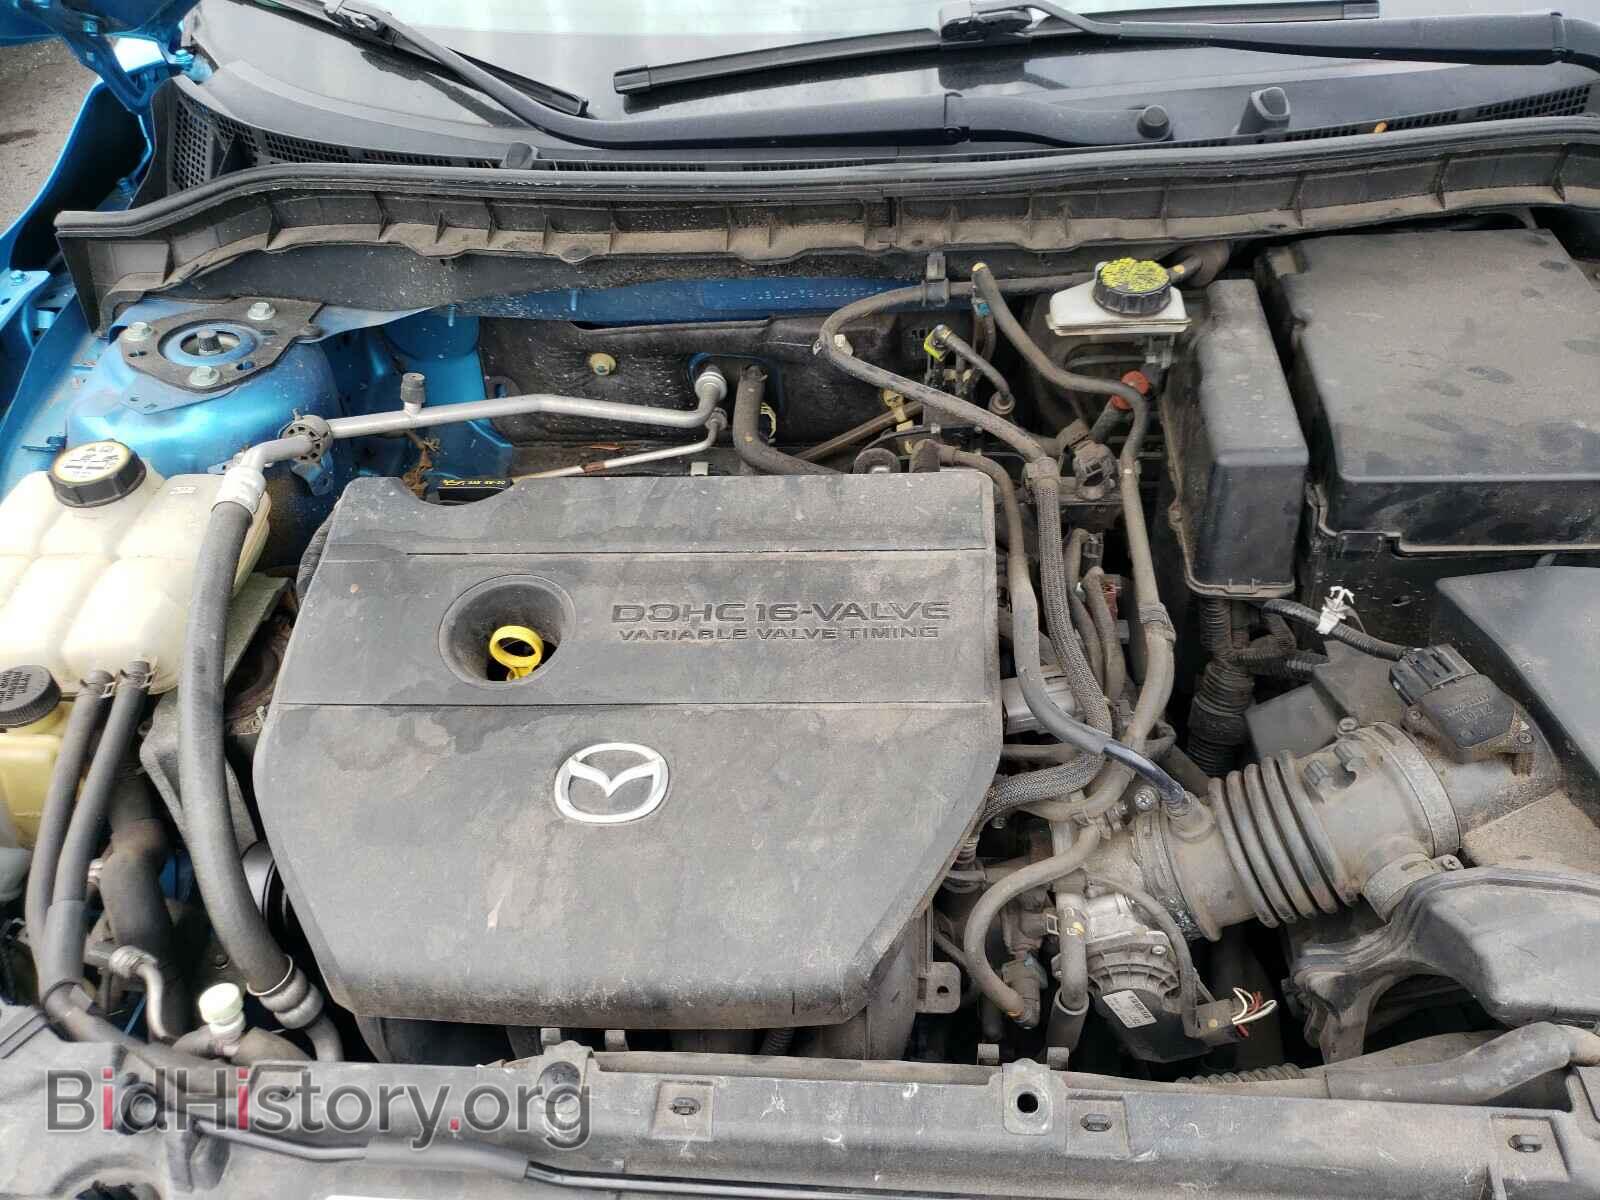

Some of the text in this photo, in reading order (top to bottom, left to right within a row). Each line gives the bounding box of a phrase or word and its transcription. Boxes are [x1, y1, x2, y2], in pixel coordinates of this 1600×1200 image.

[612, 602, 950, 622] DOHC 16-VALVE
[618, 626, 939, 641] VARIABLE VALVE TIMING
